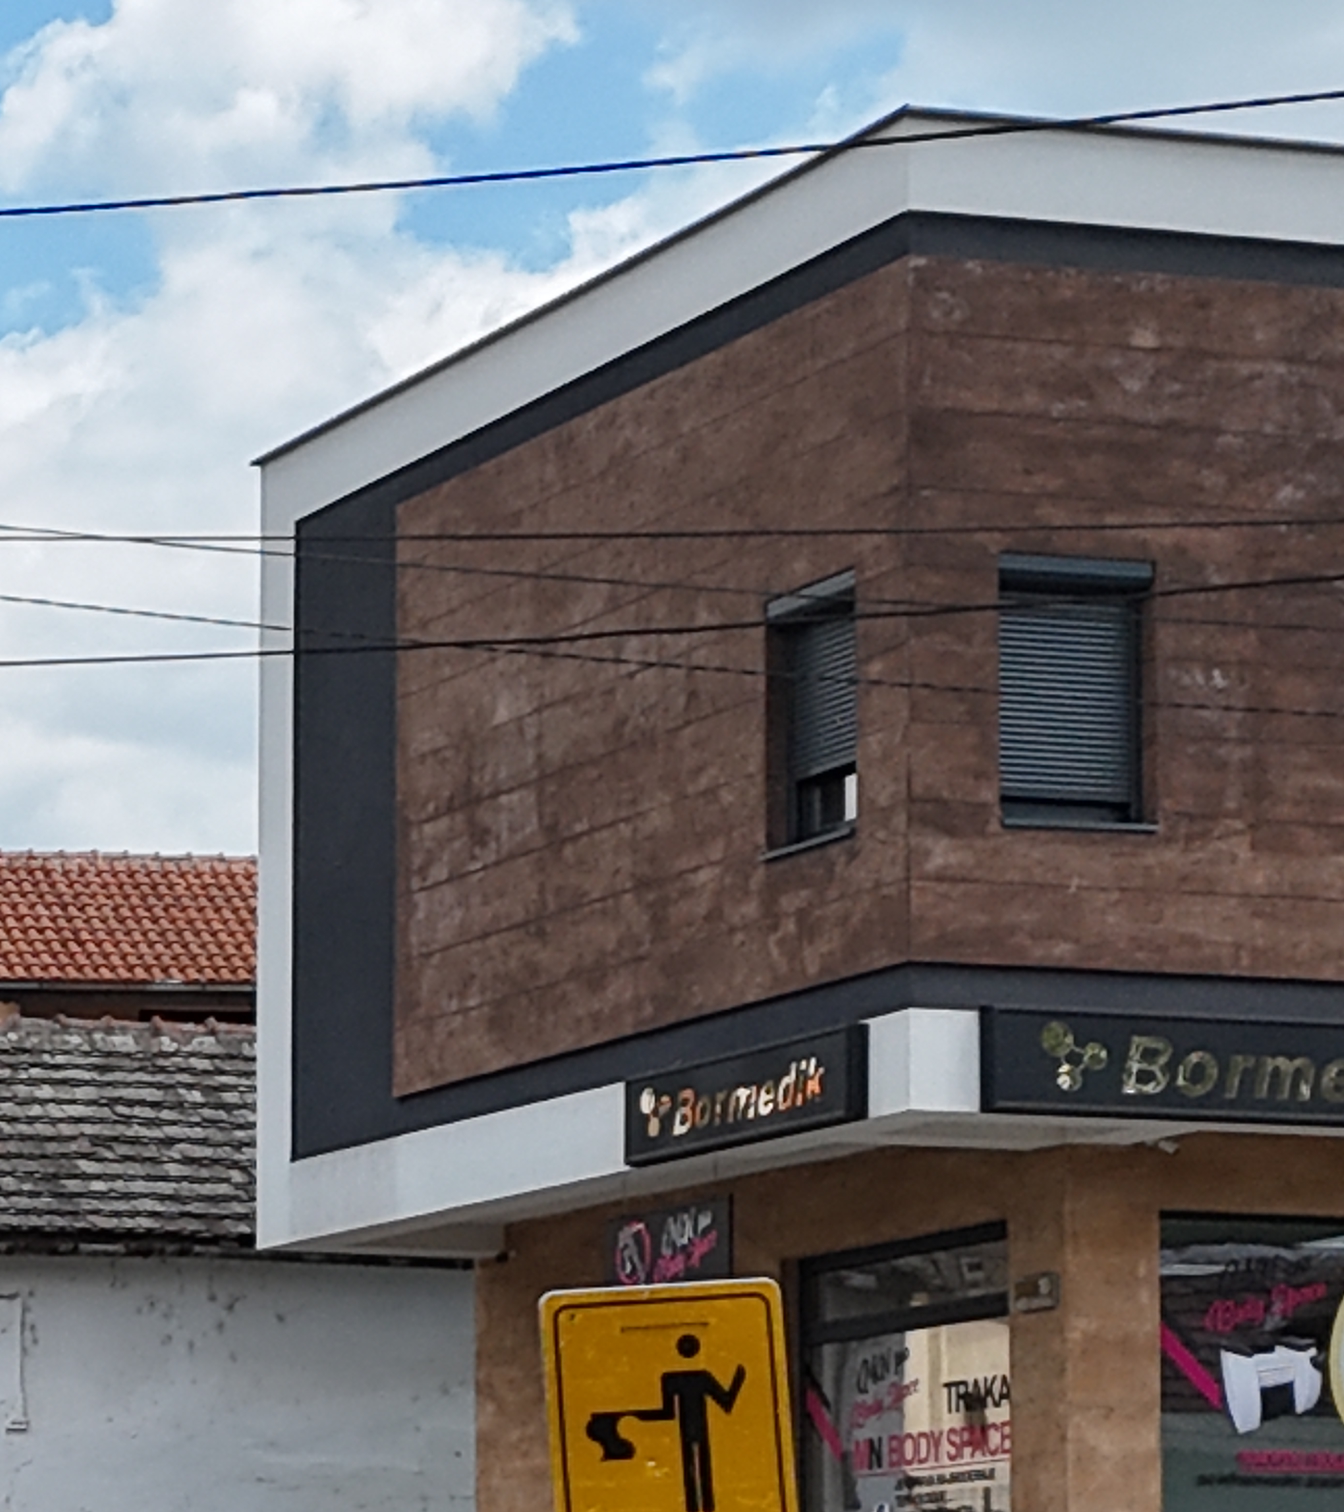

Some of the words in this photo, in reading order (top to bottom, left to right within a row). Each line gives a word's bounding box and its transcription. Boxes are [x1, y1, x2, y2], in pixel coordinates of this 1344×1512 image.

[672, 1056, 826, 1136] Bormedik
[888, 1430, 944, 1469] BODY
[946, 1420, 1010, 1462] SPACE
